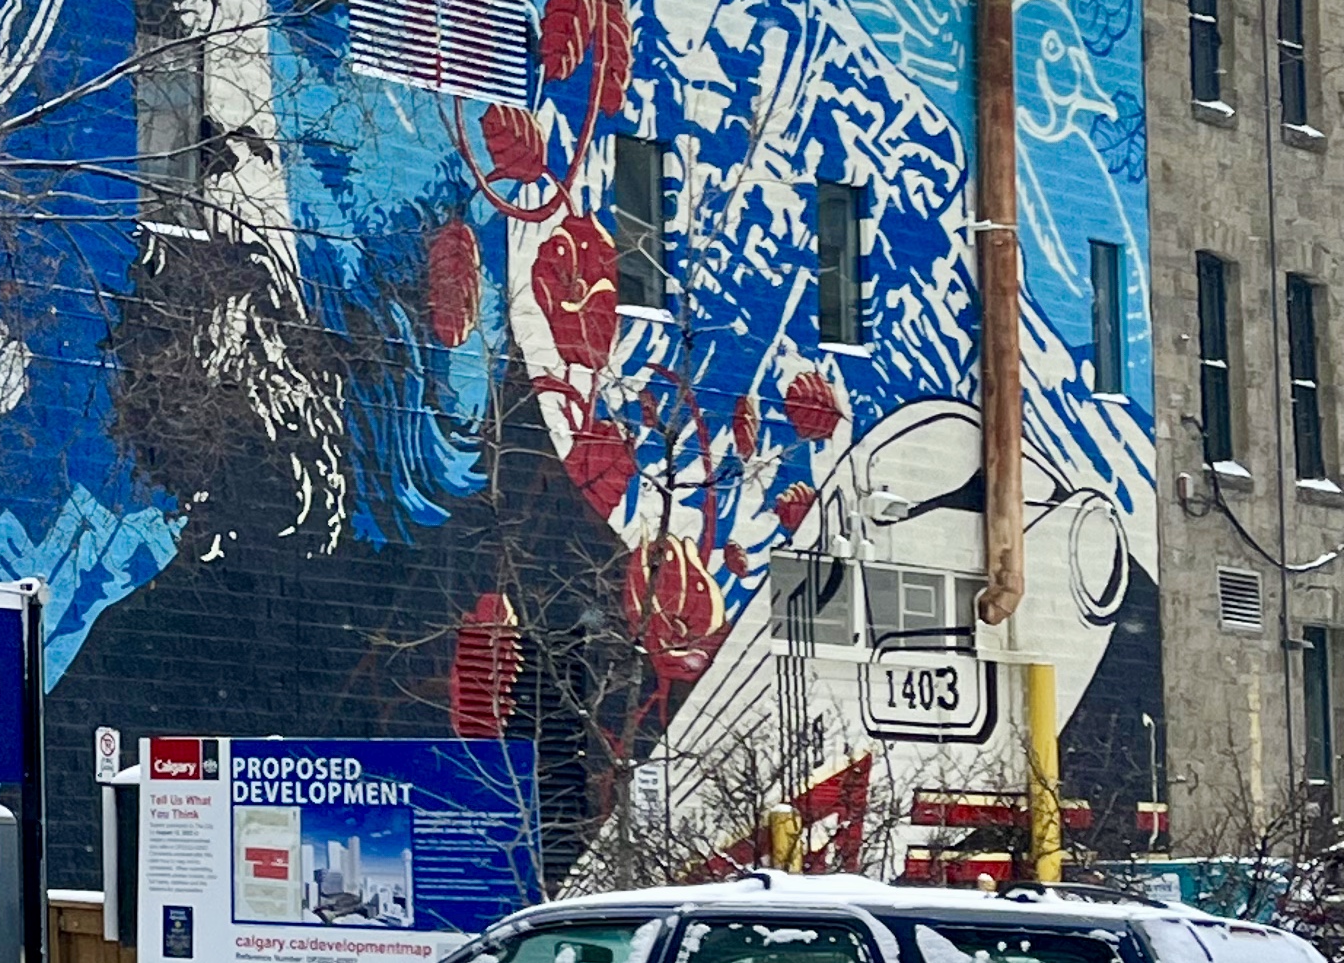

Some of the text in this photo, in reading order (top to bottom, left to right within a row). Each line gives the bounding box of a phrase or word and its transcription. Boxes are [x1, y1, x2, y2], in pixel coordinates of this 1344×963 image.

[885, 665, 960, 711] 1403
[153, 757, 197, 777] Calgary
[232, 757, 362, 781] PROPOSED
[150, 794, 212, 806] Tell Us What
[232, 781, 413, 805] DEVELOPMENT
[150, 808, 200, 819] You Think
[235, 934, 432, 959] calgary.ca/developmentmap
